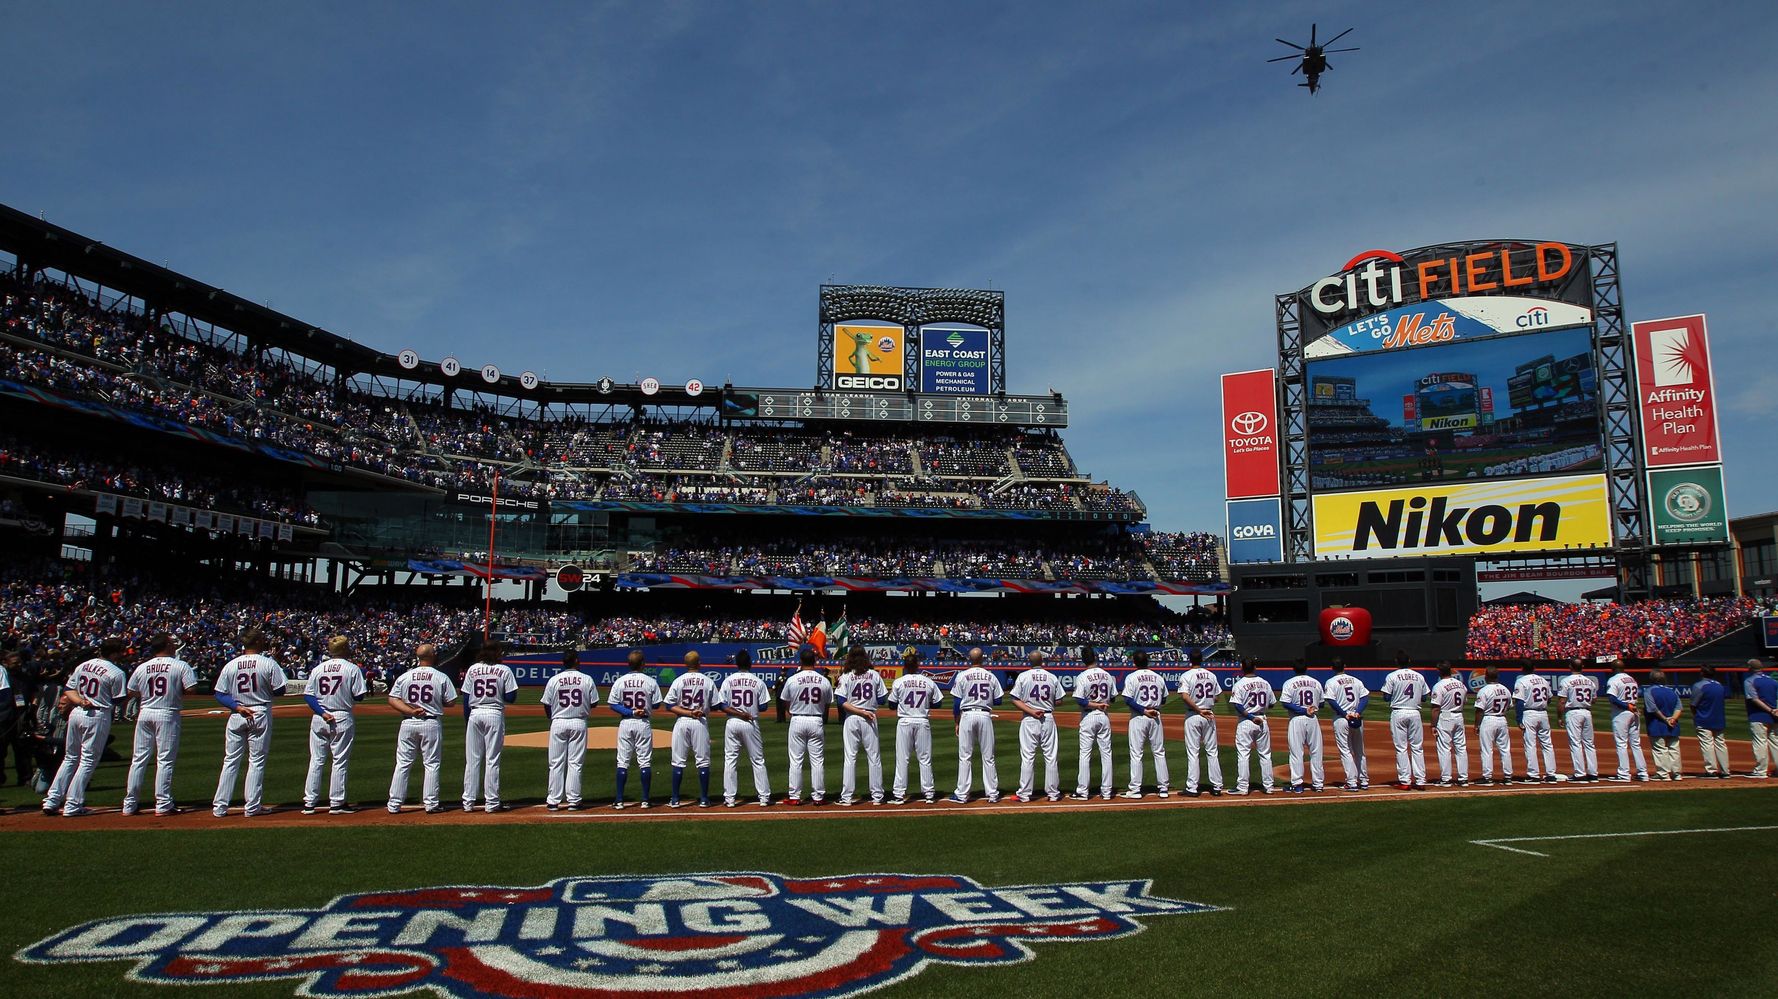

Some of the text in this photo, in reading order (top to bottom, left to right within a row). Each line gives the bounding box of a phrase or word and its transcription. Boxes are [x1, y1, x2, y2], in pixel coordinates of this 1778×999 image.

[1311, 242, 1572, 313] citi FIELD
[1348, 314, 1388, 336] LET'S
[1516, 311, 1548, 327] citi
[1371, 325, 1391, 338] GO
[1382, 313, 1456, 349] Mets
[403, 354, 414, 364] 31
[925, 349, 985, 359] EAST COAST
[445, 362, 456, 371] 41
[486, 369, 495, 378] 14
[523, 376, 534, 385] 37
[688, 383, 700, 392] 42
[838, 376, 899, 389] GEICO
[1648, 388, 1704, 403] Affinity
[1653, 405, 1703, 420] Health
[1430, 418, 1468, 428] Nikon
[1664, 422, 1695, 435] Plan
[1228, 435, 1272, 448] TOYOTA
[458, 494, 538, 509] PORSCHE
[1353, 496, 1560, 550] Nikon
[1234, 524, 1273, 538] GOYA
[146, 663, 171, 674] BRUCE
[237, 659, 257, 671] DUDA
[323, 664, 341, 673] LUGO
[237, 672, 257, 693] 21
[558, 676, 583, 686] SALAS
[623, 679, 645, 689] KELLY
[682, 678, 705, 687] RIVERA
[797, 675, 823, 686] SMOKER
[964, 672, 993, 681] WHEELER
[1031, 673, 1048, 682] REED
[1136, 675, 1158, 684] HARVEY
[1397, 673, 1419, 682] FLORES
[79, 675, 100, 698] 20
[147, 676, 167, 697] 19
[319, 676, 342, 696] 67
[474, 679, 497, 698] 65
[851, 682, 873, 700] 48
[903, 680, 928, 689] ROBLES
[968, 683, 990, 701] 45
[1089, 682, 1108, 700] 39
[1195, 683, 1214, 700] 32
[1404, 684, 1414, 700] 4
[408, 684, 433, 703] 66
[558, 689, 582, 708] 59
[622, 691, 646, 709] 56
[682, 689, 704, 707] 54
[731, 689, 754, 707] 50
[798, 687, 822, 705] 49
[904, 691, 927, 709] 47
[1030, 684, 1051, 701] 43
[1139, 685, 1159, 702] 33
[1248, 691, 1266, 707] 30
[1299, 690, 1313, 706] 18
[1345, 687, 1355, 702] 5
[1454, 692, 1461, 707] 6
[1533, 687, 1548, 702] 23
[1576, 688, 1592, 702] 53
[1625, 686, 1637, 700] 22
[1493, 699, 1509, 714] 57
[46, 884, 1194, 956] OPENING WEEK
